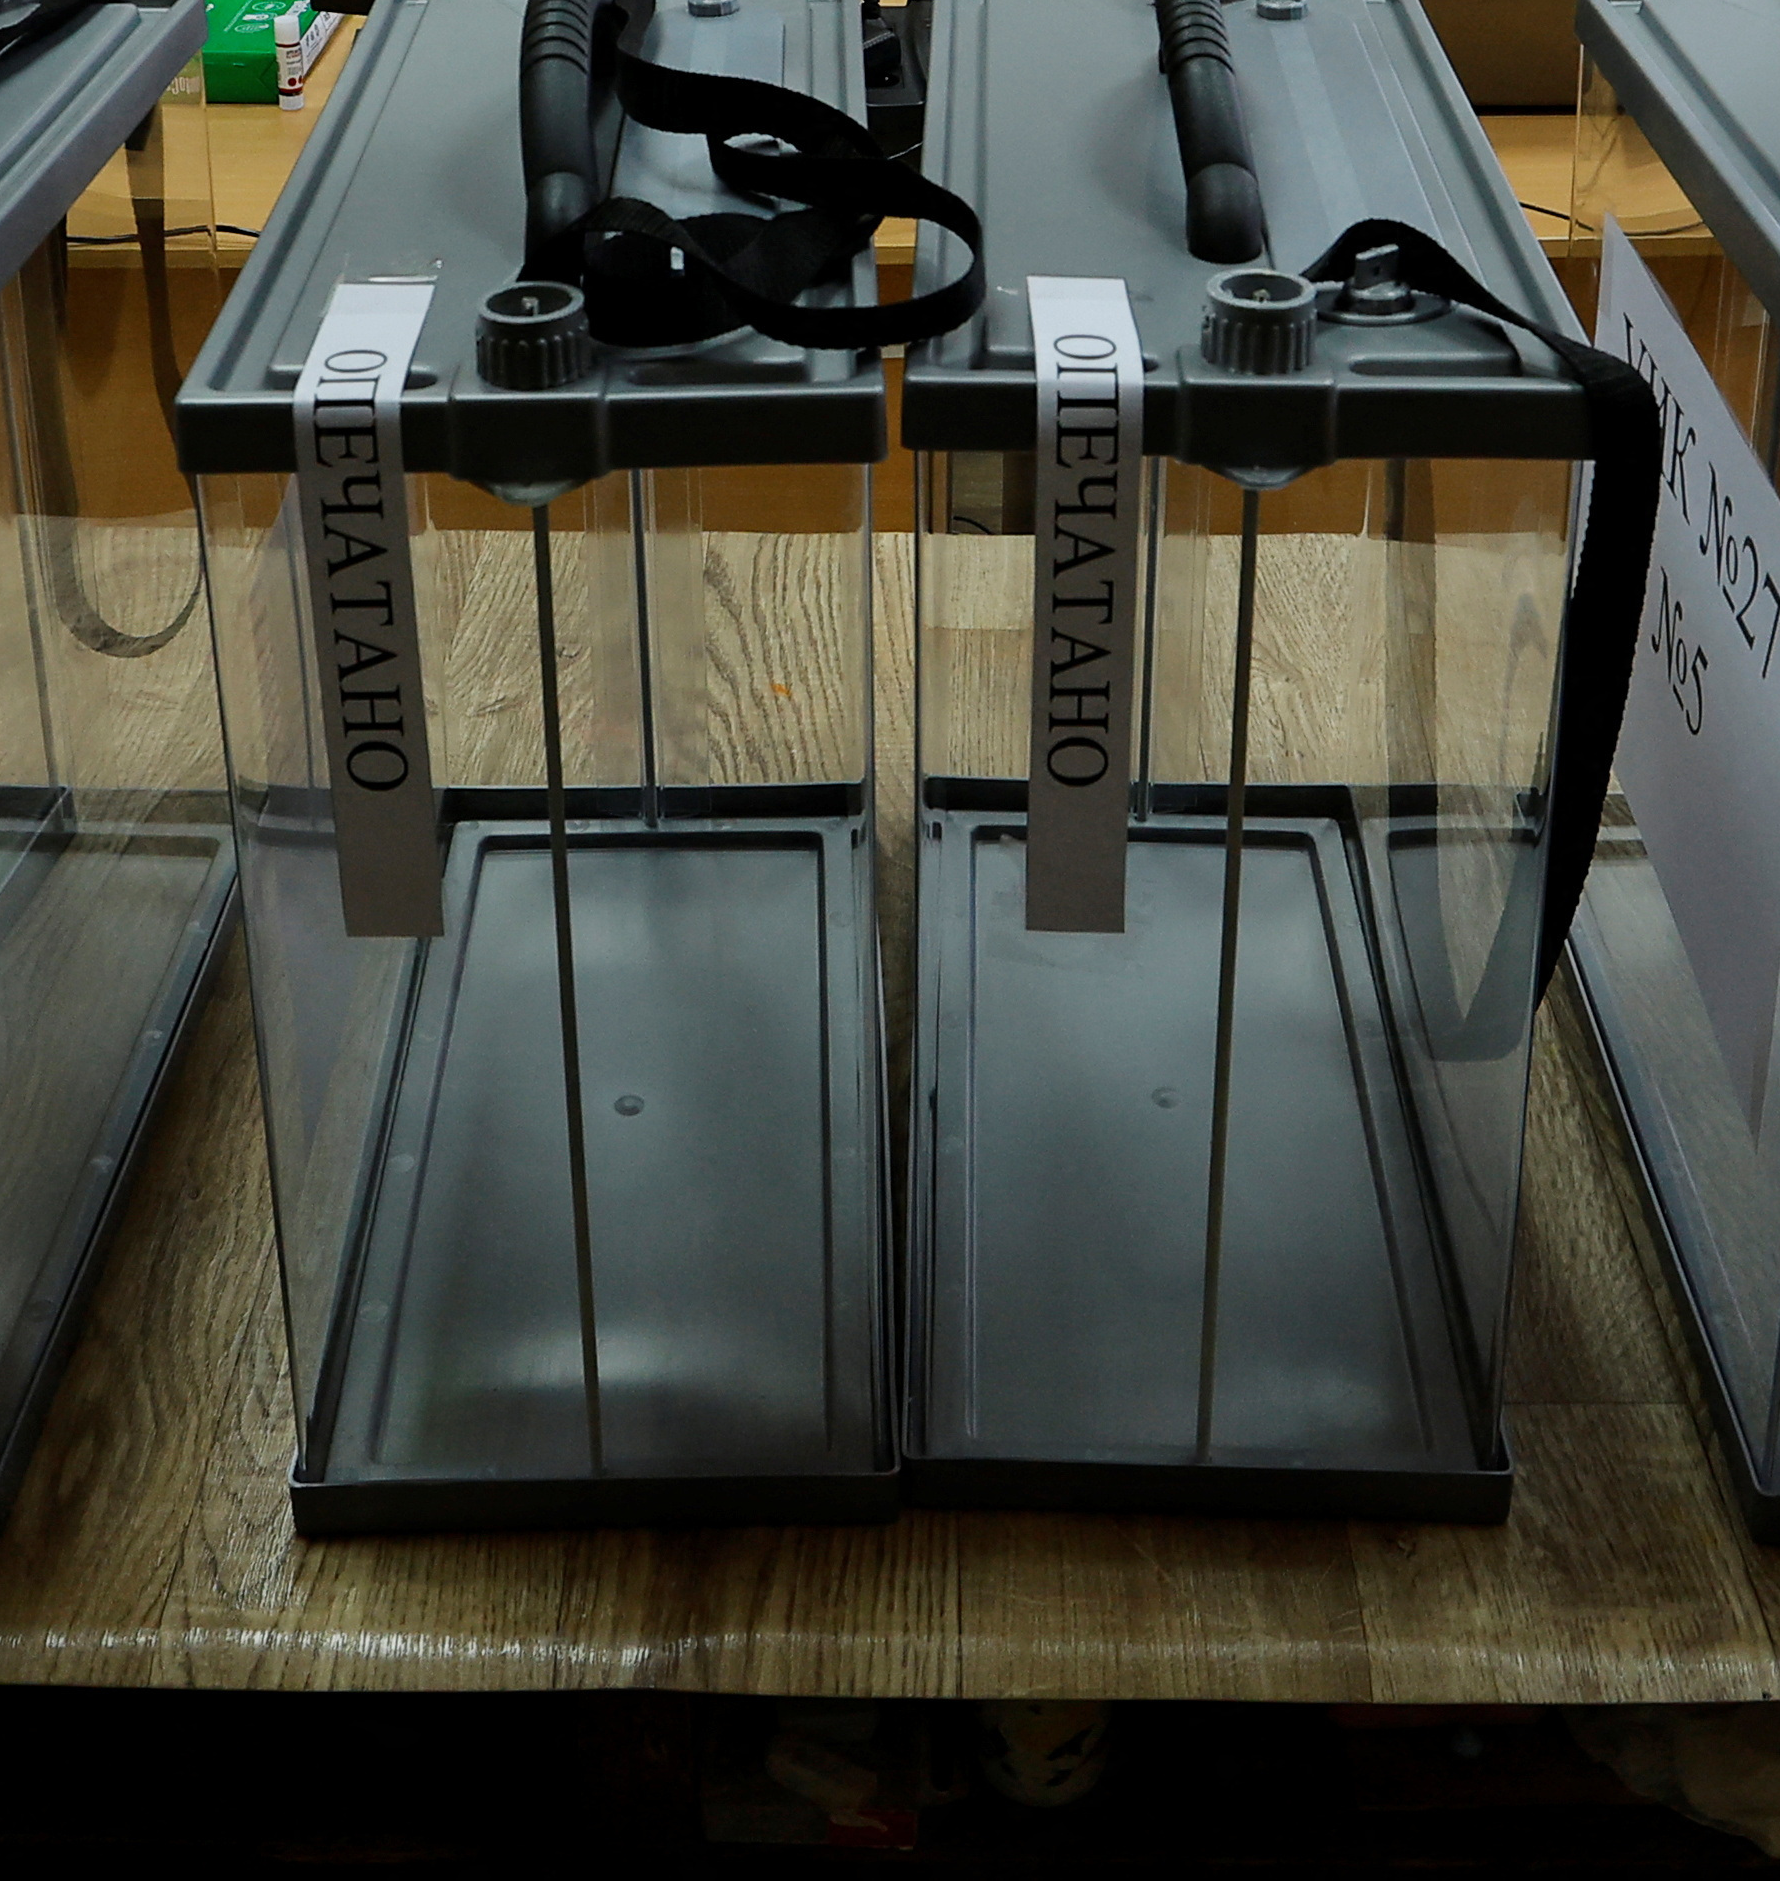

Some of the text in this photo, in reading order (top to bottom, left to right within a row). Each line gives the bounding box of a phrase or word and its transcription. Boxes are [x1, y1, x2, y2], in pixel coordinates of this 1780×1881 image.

[313, 349, 410, 793] ОПЕЧАТАНО
[1047, 334, 1121, 789] ОПЕЧАТАНО
[1651, 566, 1708, 736] №5
